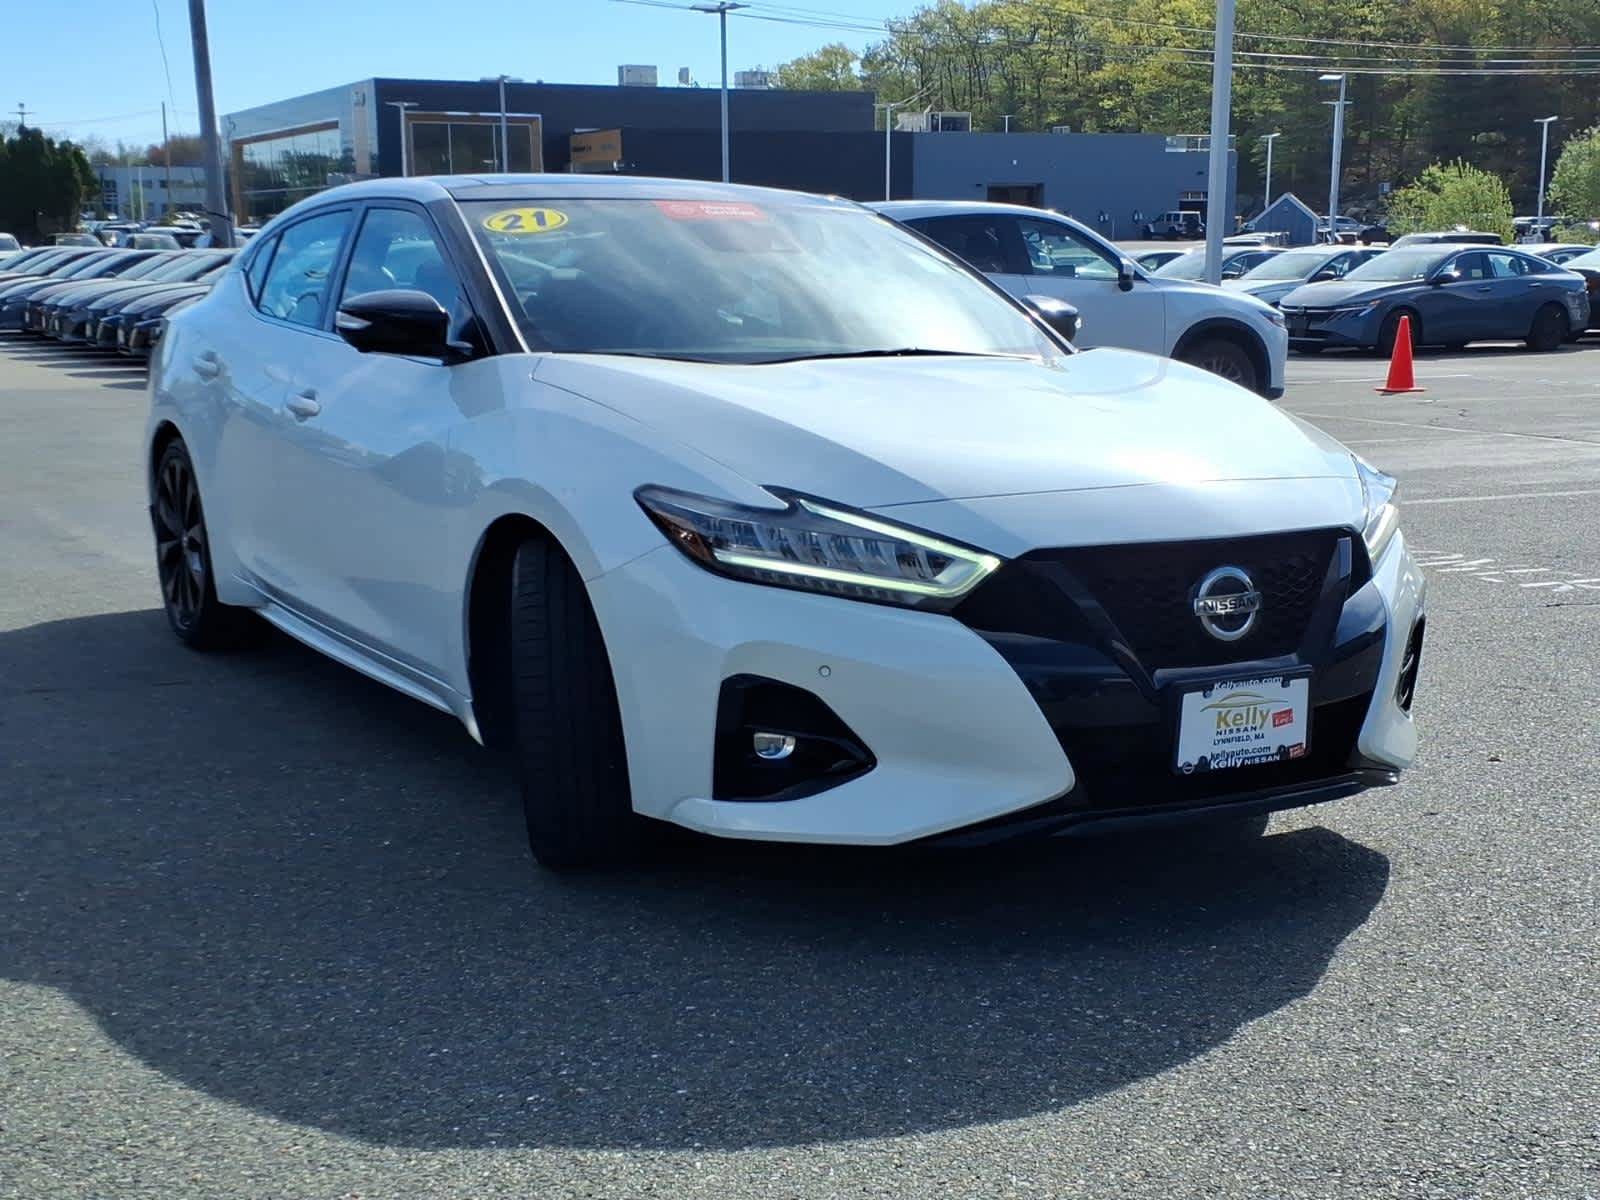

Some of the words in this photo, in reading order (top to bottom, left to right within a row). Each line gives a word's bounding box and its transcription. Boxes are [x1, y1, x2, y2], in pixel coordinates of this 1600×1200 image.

[502, 211, 546, 230] 21
[1203, 598, 1254, 613] NISSAN
[1216, 707, 1270, 730] Kelly
[1216, 726, 1257, 736] NISSAN
[1210, 756, 1243, 769] Kelly
[1244, 755, 1280, 765] NISSAN
